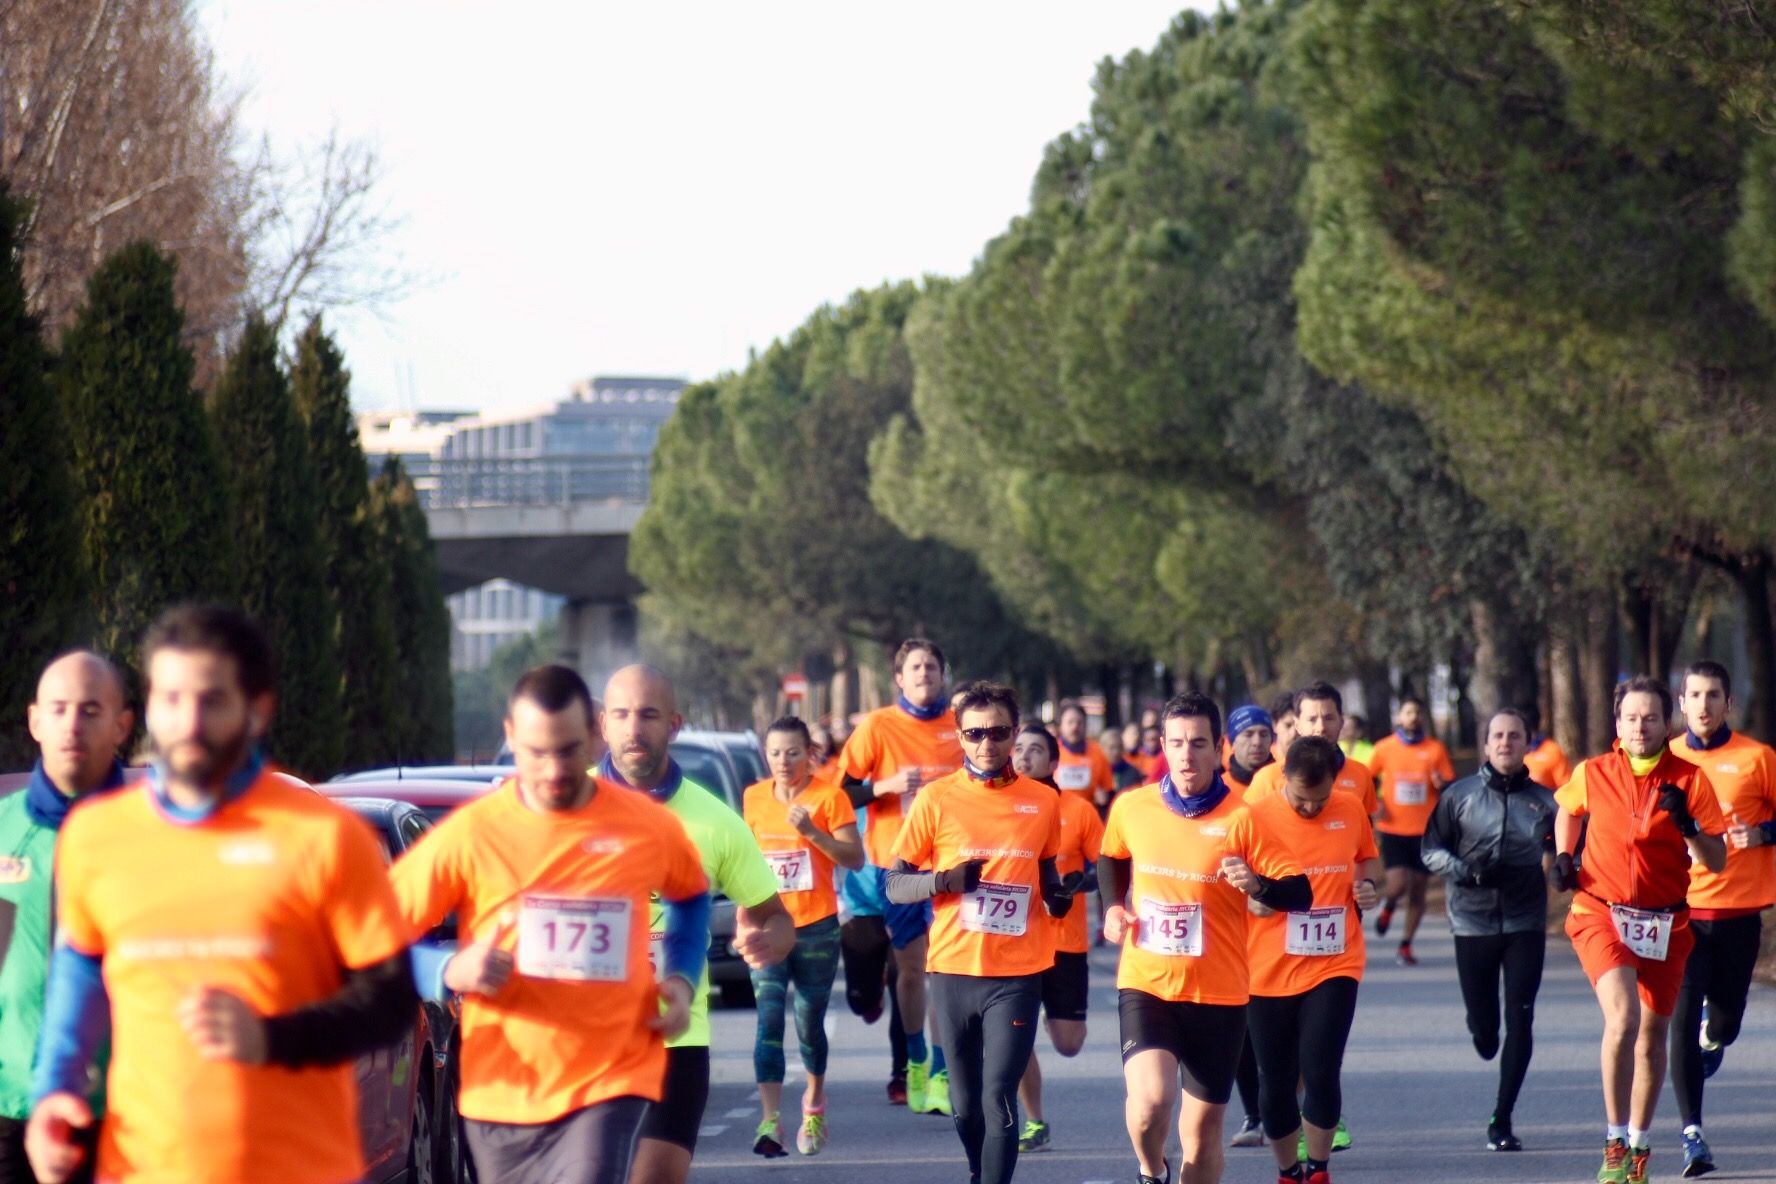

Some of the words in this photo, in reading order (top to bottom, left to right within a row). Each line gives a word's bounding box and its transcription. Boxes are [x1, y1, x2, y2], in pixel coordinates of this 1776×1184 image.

[1176, 868, 1188, 880] by
[1189, 872, 1218, 884] RICOH
[976, 896, 1017, 918] 179
[543, 921, 610, 954] 173
[1150, 916, 1188, 939] 145
[1299, 922, 1337, 941] 114
[1621, 921, 1659, 944] 134
